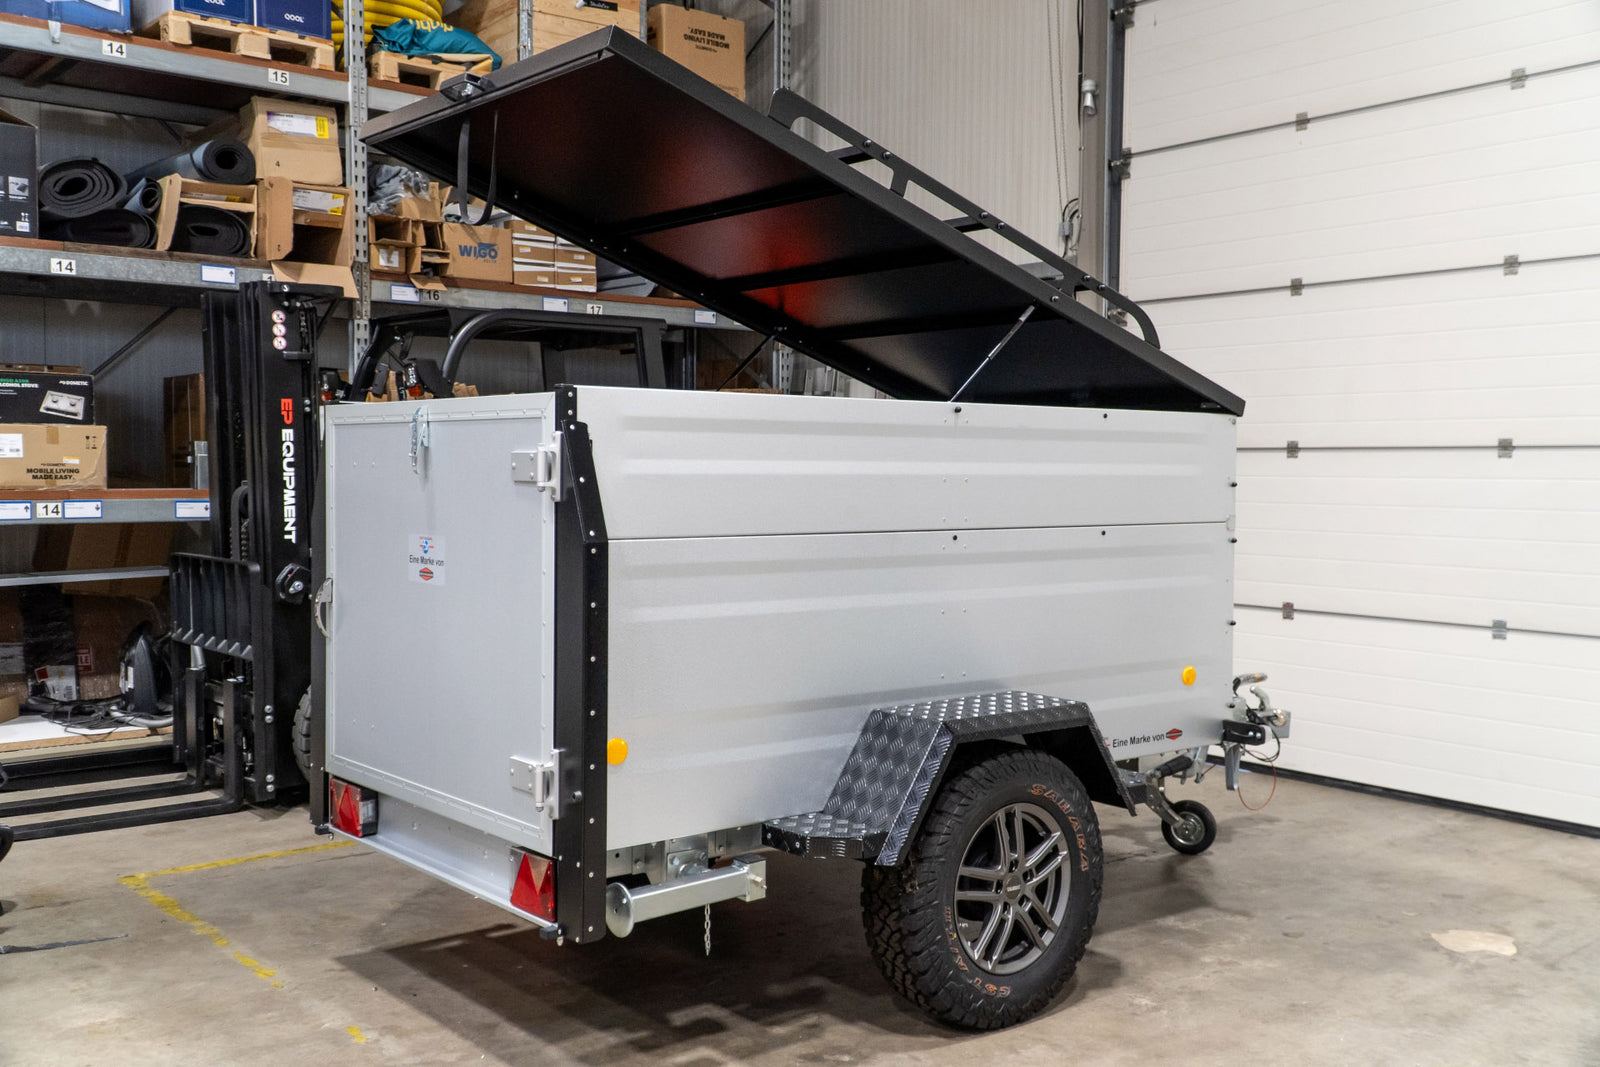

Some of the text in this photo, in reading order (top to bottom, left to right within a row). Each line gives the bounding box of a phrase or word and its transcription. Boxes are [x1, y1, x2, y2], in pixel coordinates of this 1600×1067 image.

[684, 33, 729, 49] MOBILE LIVING
[707, 31, 725, 41] MADE
[106, 43, 125, 56] 14
[272, 71, 288, 84] 15
[458, 243, 498, 260] WIGO
[56, 260, 74, 273] 14
[427, 290, 440, 301] 16
[590, 304, 602, 315] 17
[281, 398, 297, 544] EP EQUIPMENT
[42, 504, 61, 516] 14
[409, 555, 419, 564] Eine
[420, 556, 435, 565] Marke
[1112, 733, 1165, 748] Eine Marke von
